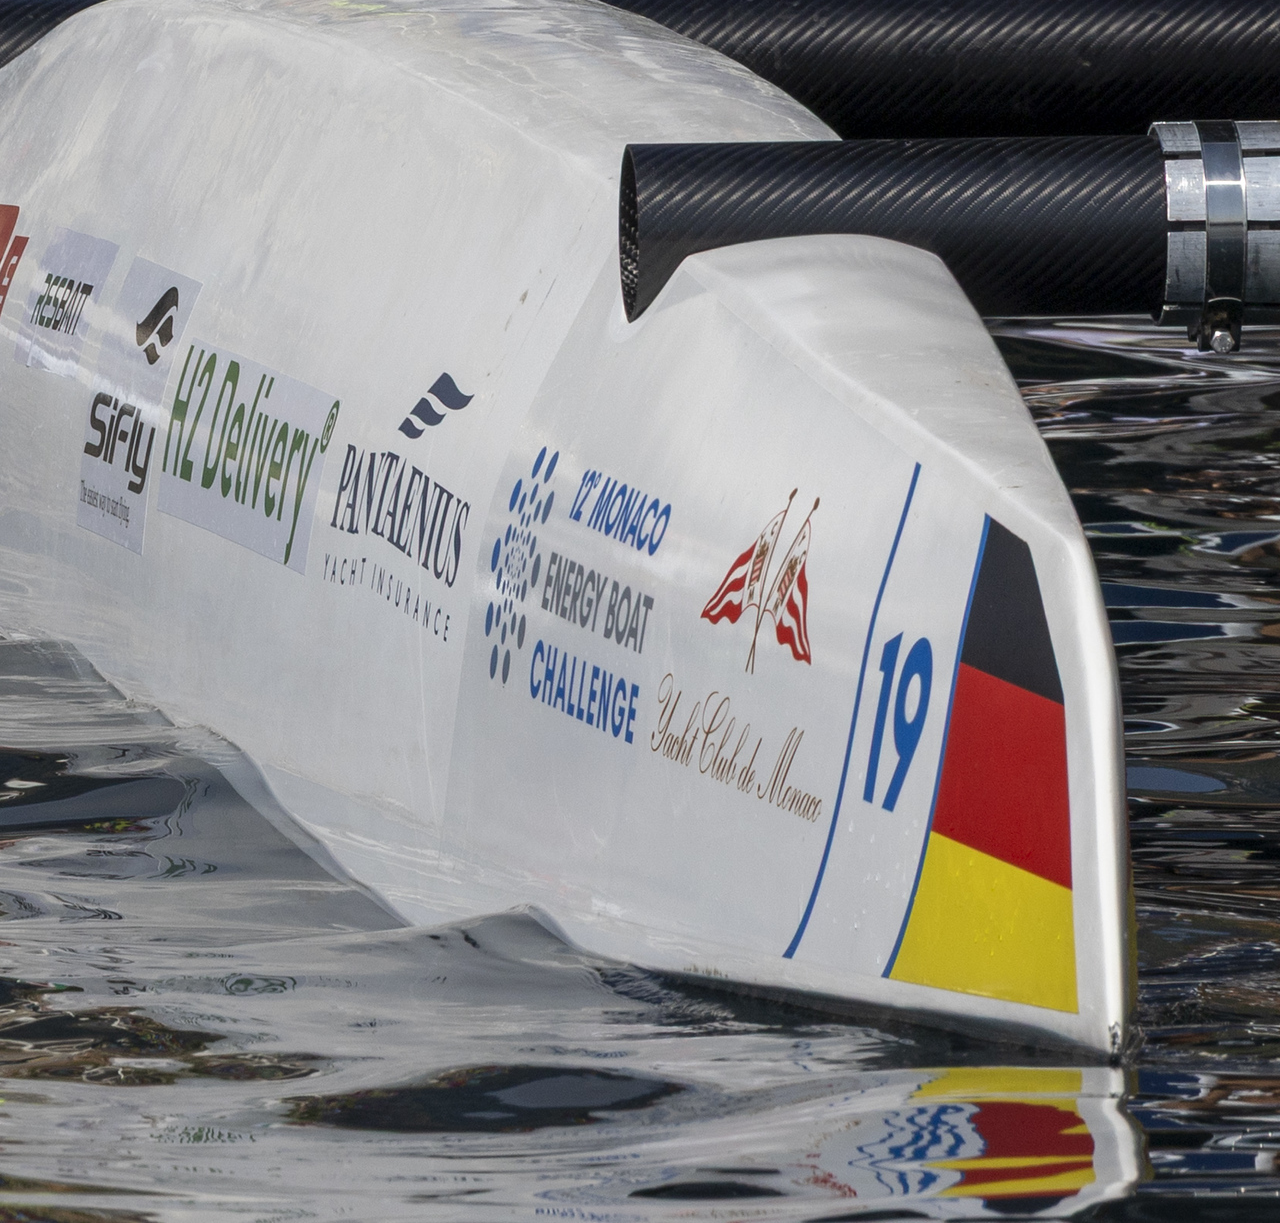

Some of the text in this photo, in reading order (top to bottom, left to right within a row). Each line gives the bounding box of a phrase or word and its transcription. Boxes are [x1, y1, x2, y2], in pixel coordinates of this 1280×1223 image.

[162, 344, 218, 484] H2
[330, 443, 472, 588] PANTAENIUS
[587, 476, 672, 557] MONACO
[323, 553, 451, 643] YACHT INSURANCE
[541, 551, 655, 654] ENERGY BOAT
[529, 639, 640, 745] CHALLENGE
[650, 672, 823, 823] Yacht Club de Monaco
[862, 631, 933, 813] 19
